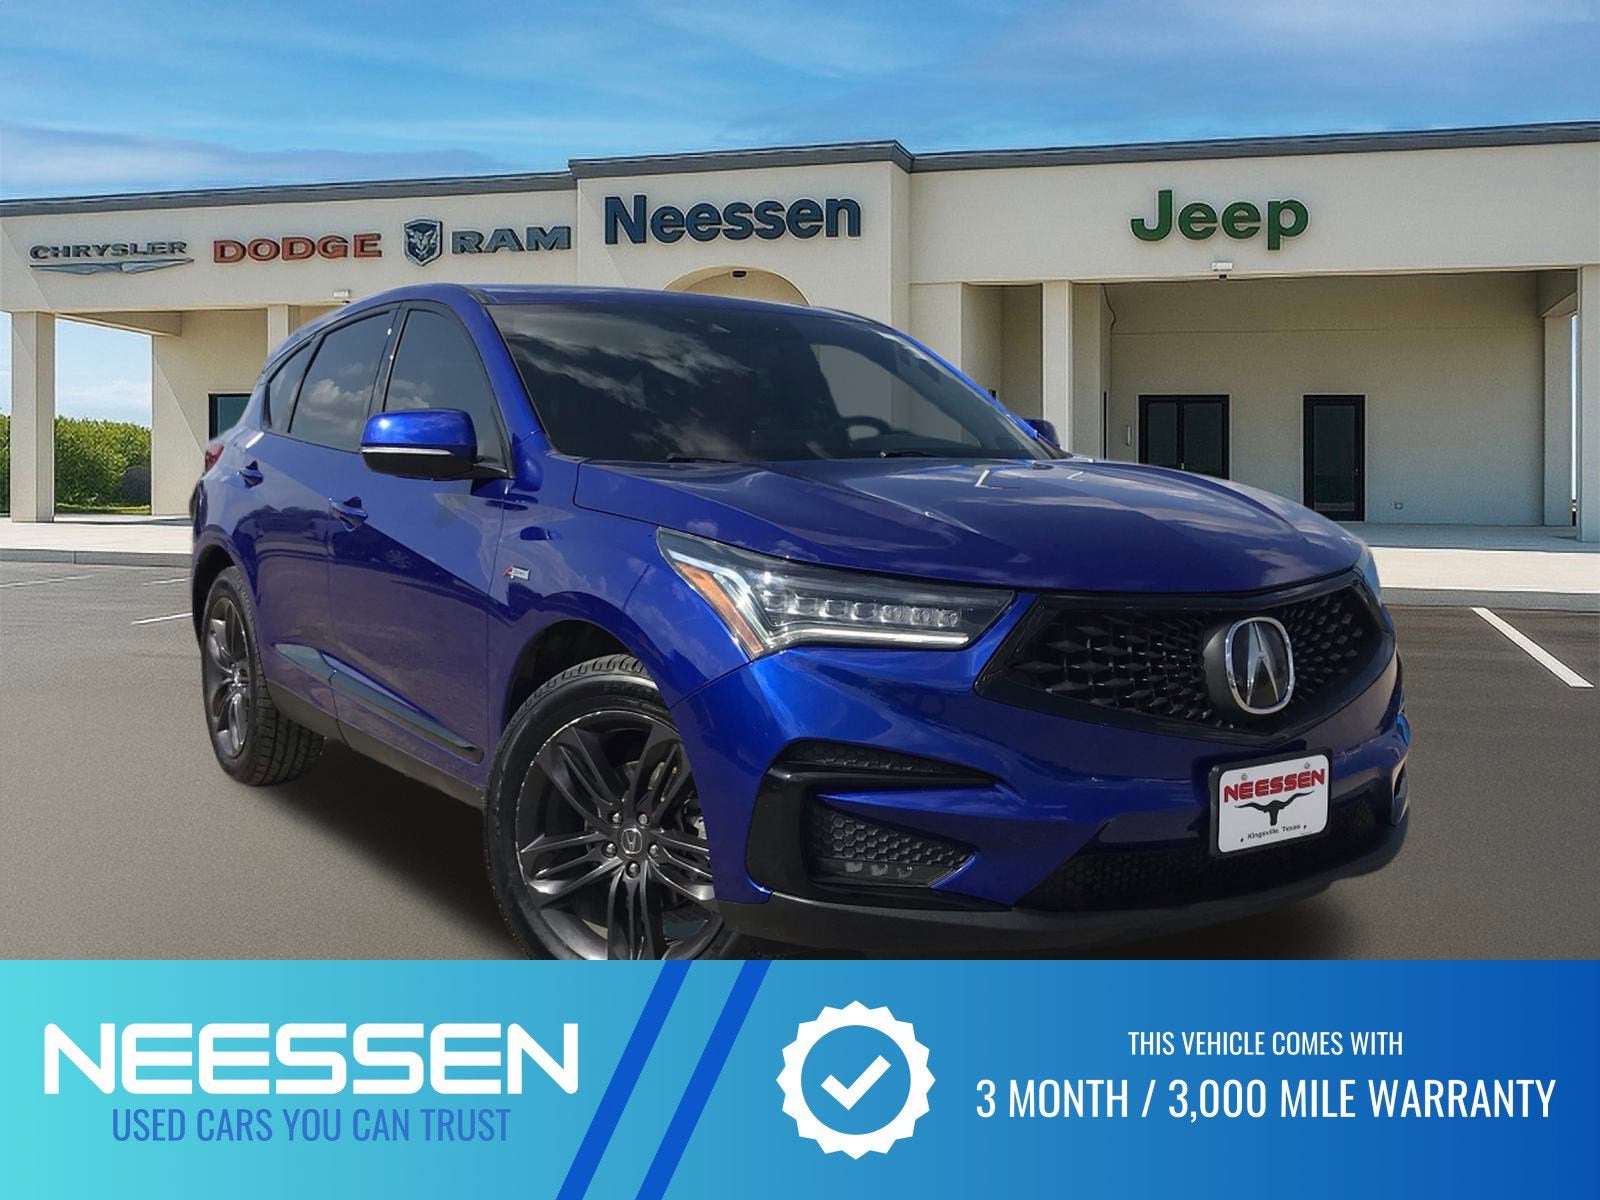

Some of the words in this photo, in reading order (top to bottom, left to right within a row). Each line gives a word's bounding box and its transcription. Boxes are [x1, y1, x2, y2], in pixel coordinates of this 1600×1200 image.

[604, 194, 862, 245] Neessen
[1130, 189, 1309, 251] Jeep
[30, 241, 188, 260] CHRYSLER
[213, 233, 383, 264] DODGE
[451, 226, 572, 254] RAM
[1223, 768, 1326, 803] NEESSEN
